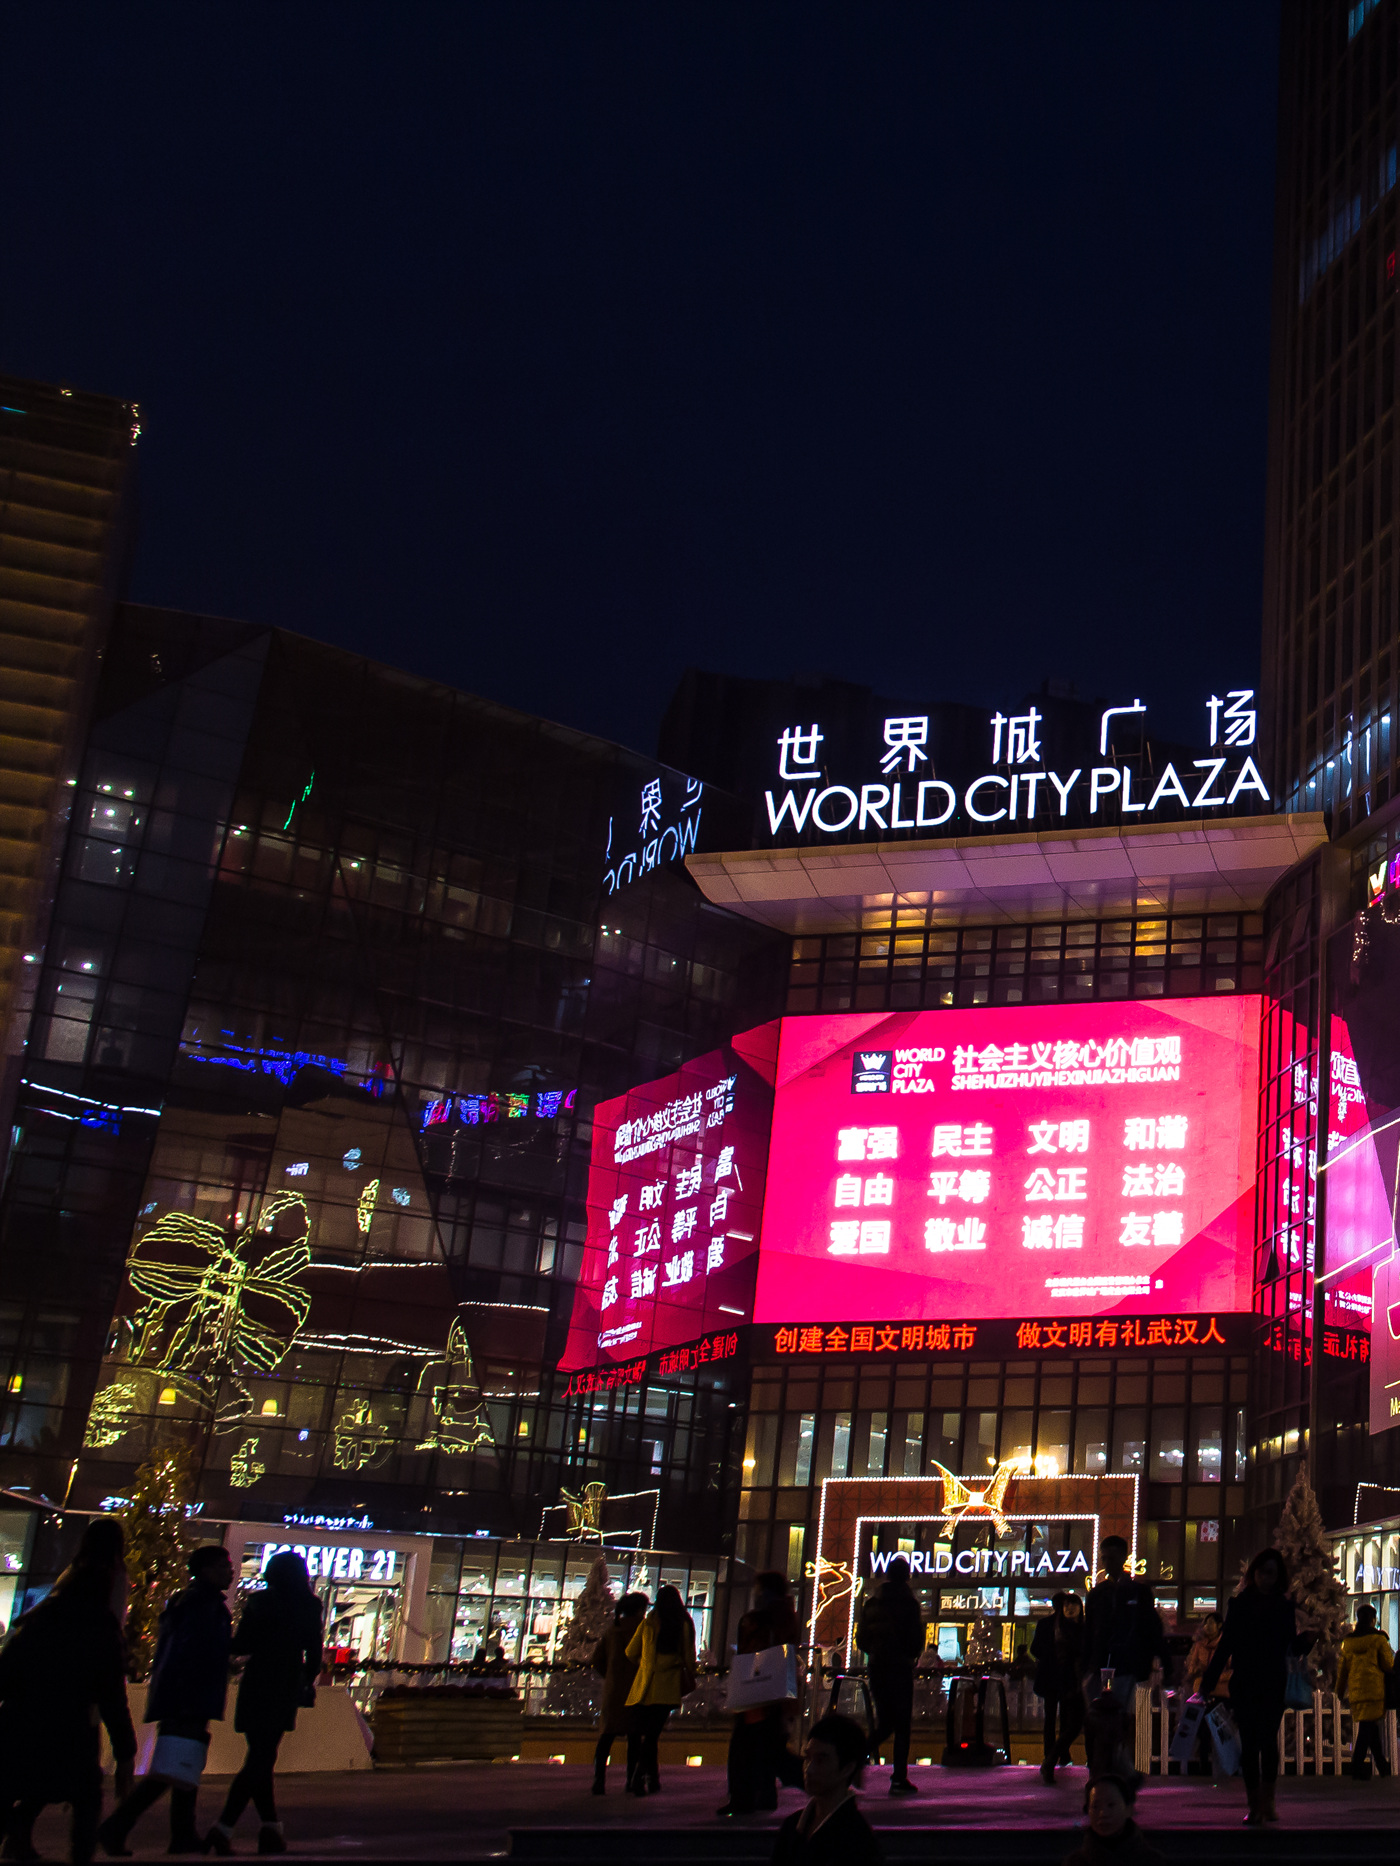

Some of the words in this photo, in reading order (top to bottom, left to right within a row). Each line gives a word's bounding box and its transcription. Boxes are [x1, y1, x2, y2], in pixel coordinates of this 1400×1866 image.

[777, 690, 1256, 780] 世界城广场
[765, 780, 956, 834] WORLD
[965, 768, 1081, 821] CITY
[1090, 756, 1270, 813] PLAZA
[893, 1063, 923, 1078] CITY
[895, 1047, 946, 1063] WORLD
[952, 1036, 1181, 1073] 社会主义核心价值观
[892, 1078, 935, 1093] PLAZA
[837, 1127, 899, 1160] 富强
[932, 1123, 993, 1157] 民主
[1027, 1118, 1090, 1153] 文明
[1124, 1115, 1188, 1151] 和谐
[834, 1173, 894, 1207] 自由
[927, 1169, 992, 1204] 平等
[1024, 1167, 1088, 1201] 公正
[1122, 1163, 1186, 1197] 法治
[827, 1220, 892, 1255] 爱国
[924, 1216, 987, 1252] 敬业
[1022, 1214, 1085, 1249] 诚信
[1119, 1211, 1184, 1246] 友善
[774, 1323, 977, 1353] 创建全国文明城市
[1016, 1318, 1226, 1349] 做文明有礼武汉人
[369, 1550, 396, 1580] 21
[955, 1550, 1008, 1573] CITY
[1010, 1550, 1089, 1574] PLAZA
[940, 1595, 1005, 1609] 西北门入口
